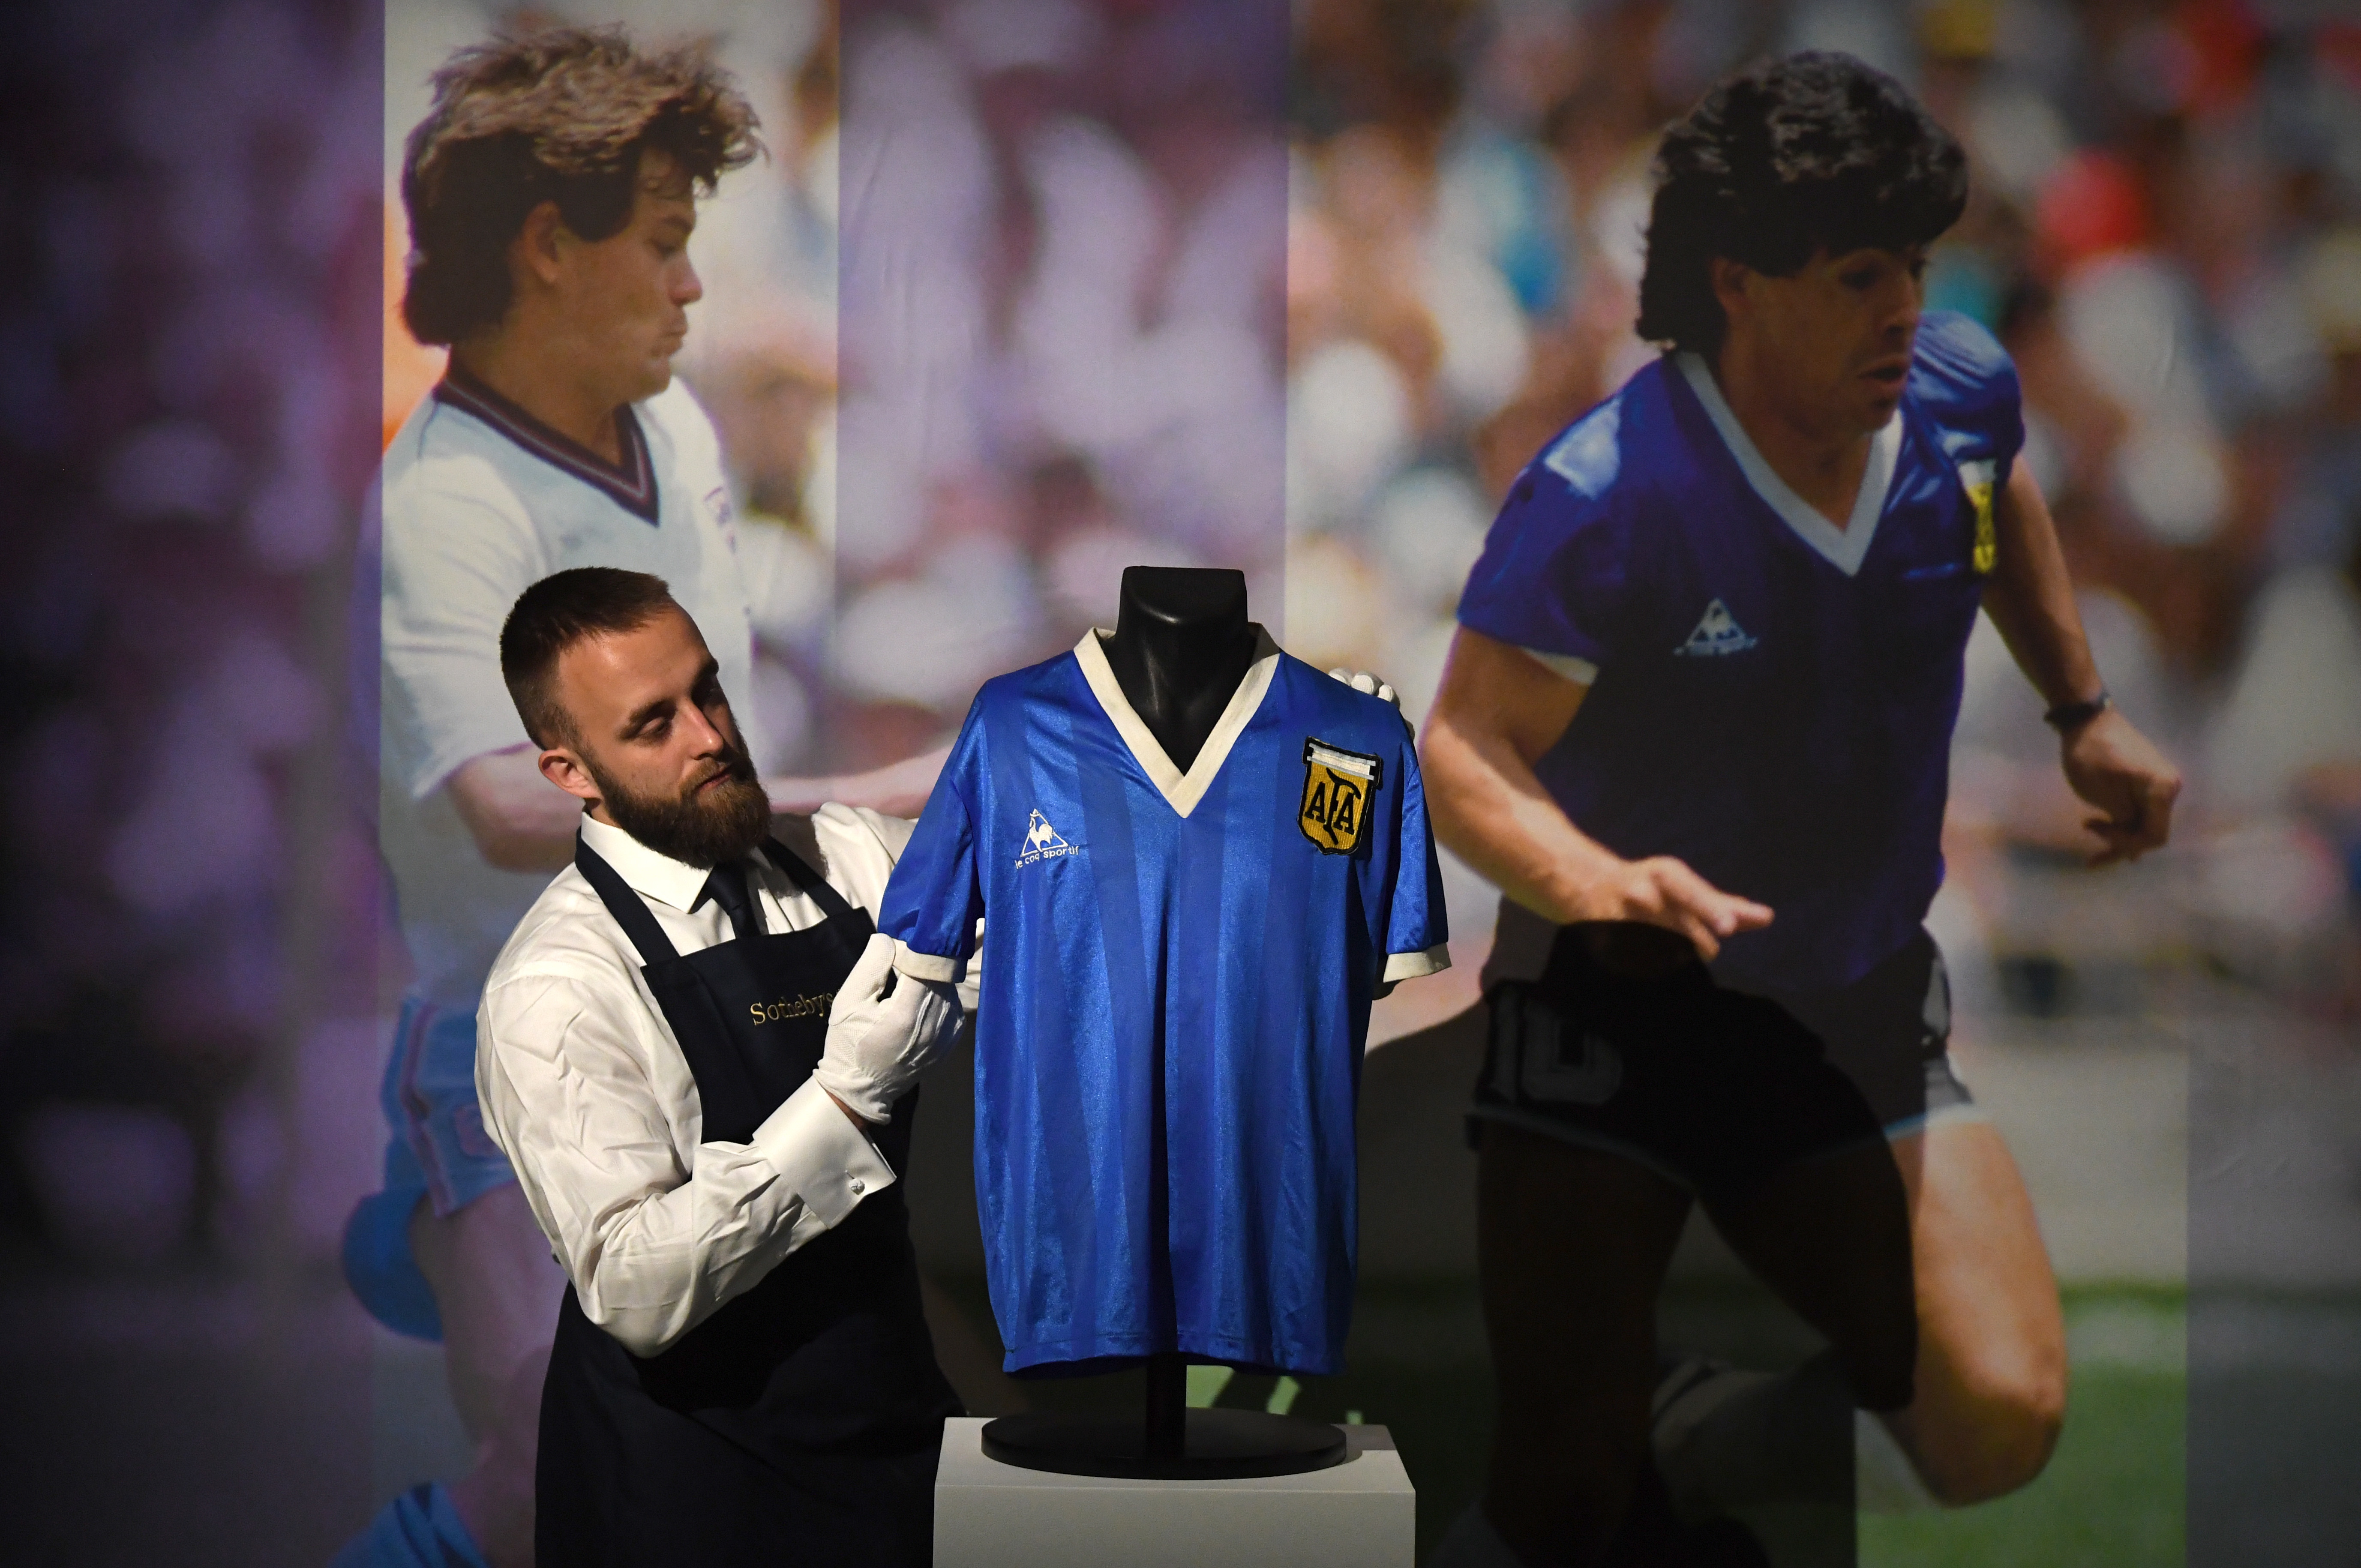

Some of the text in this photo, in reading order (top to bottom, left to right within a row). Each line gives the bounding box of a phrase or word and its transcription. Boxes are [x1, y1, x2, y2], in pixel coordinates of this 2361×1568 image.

[1014, 845, 1080, 869] le coq sportif
